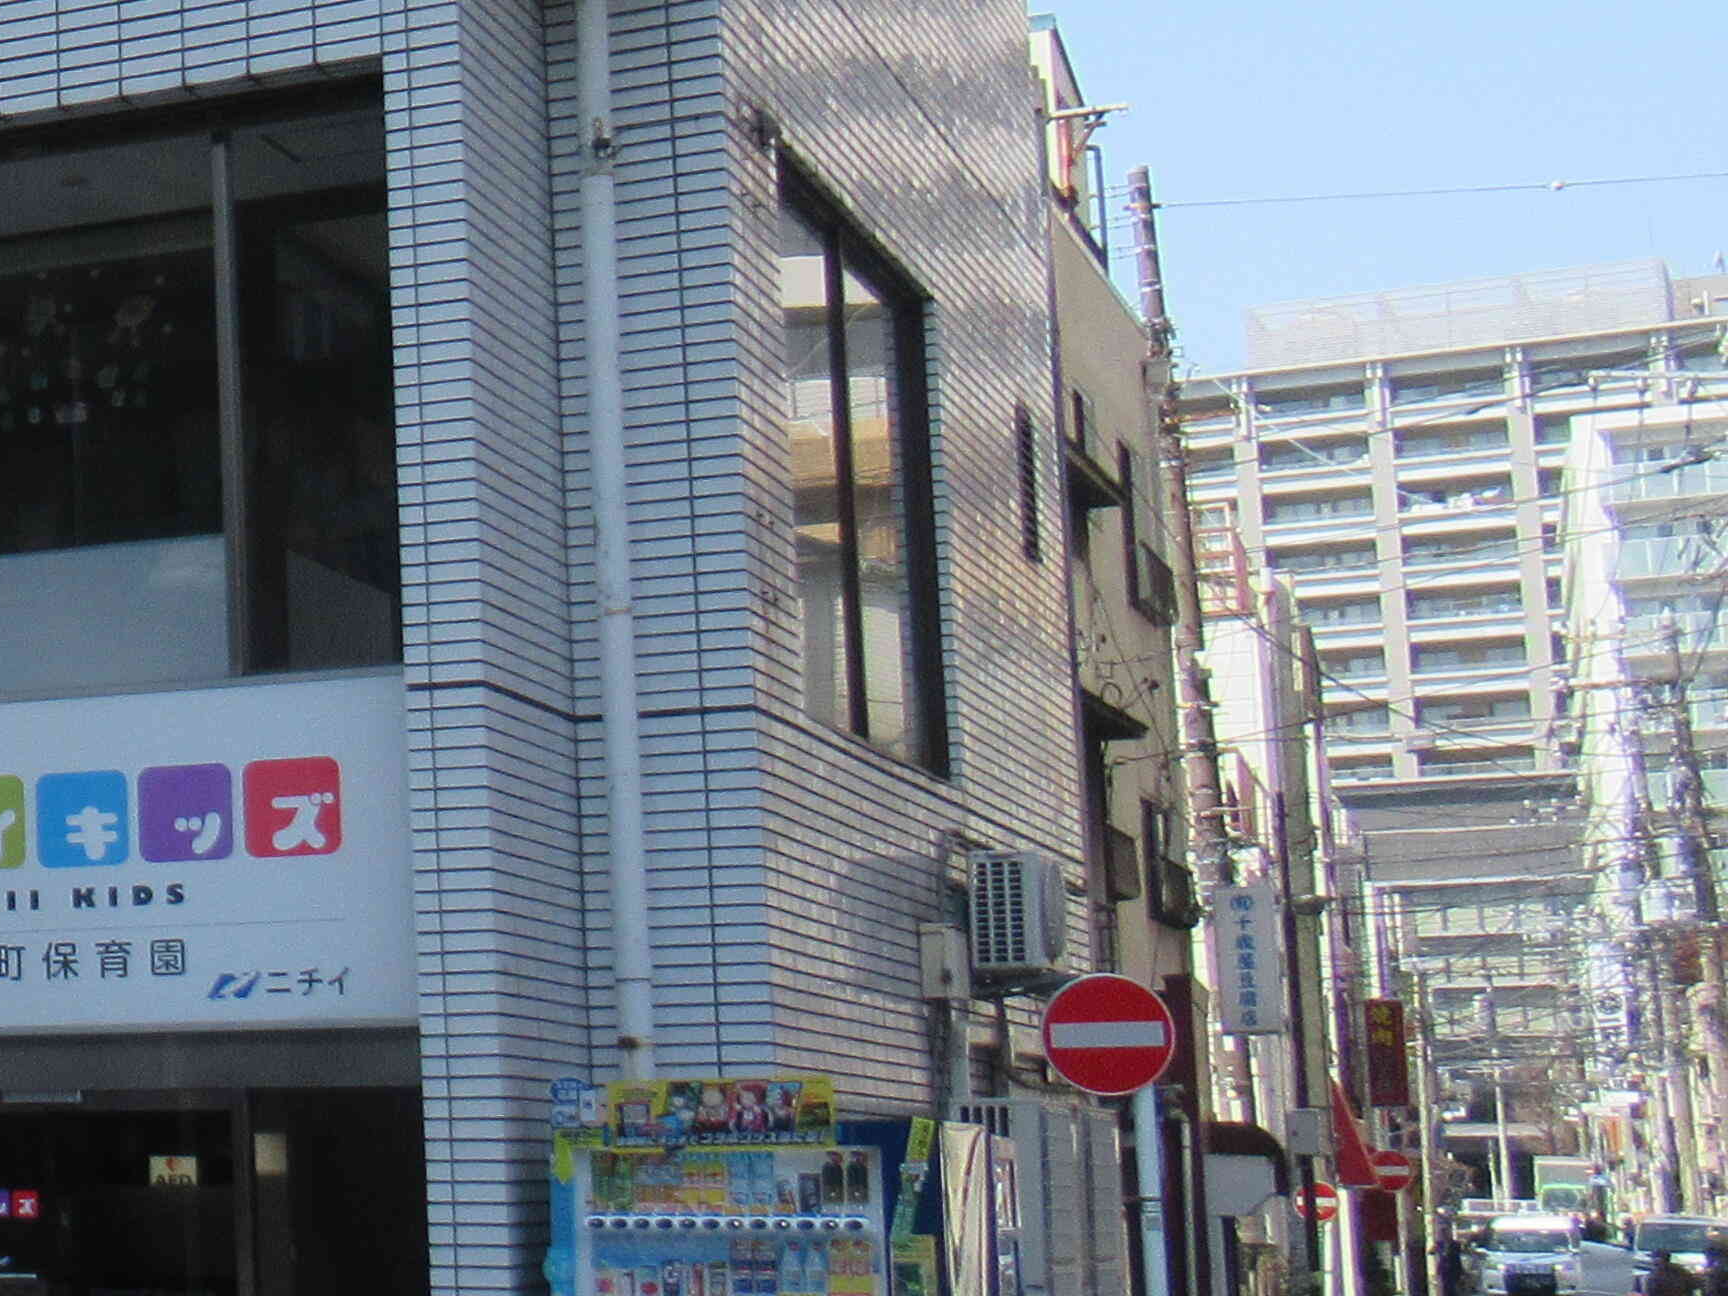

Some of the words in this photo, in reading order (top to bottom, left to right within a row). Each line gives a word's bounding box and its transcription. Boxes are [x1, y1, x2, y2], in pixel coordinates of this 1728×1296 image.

[71, 883, 188, 909] KIDS
[265, 966, 350, 997] ニチイ
